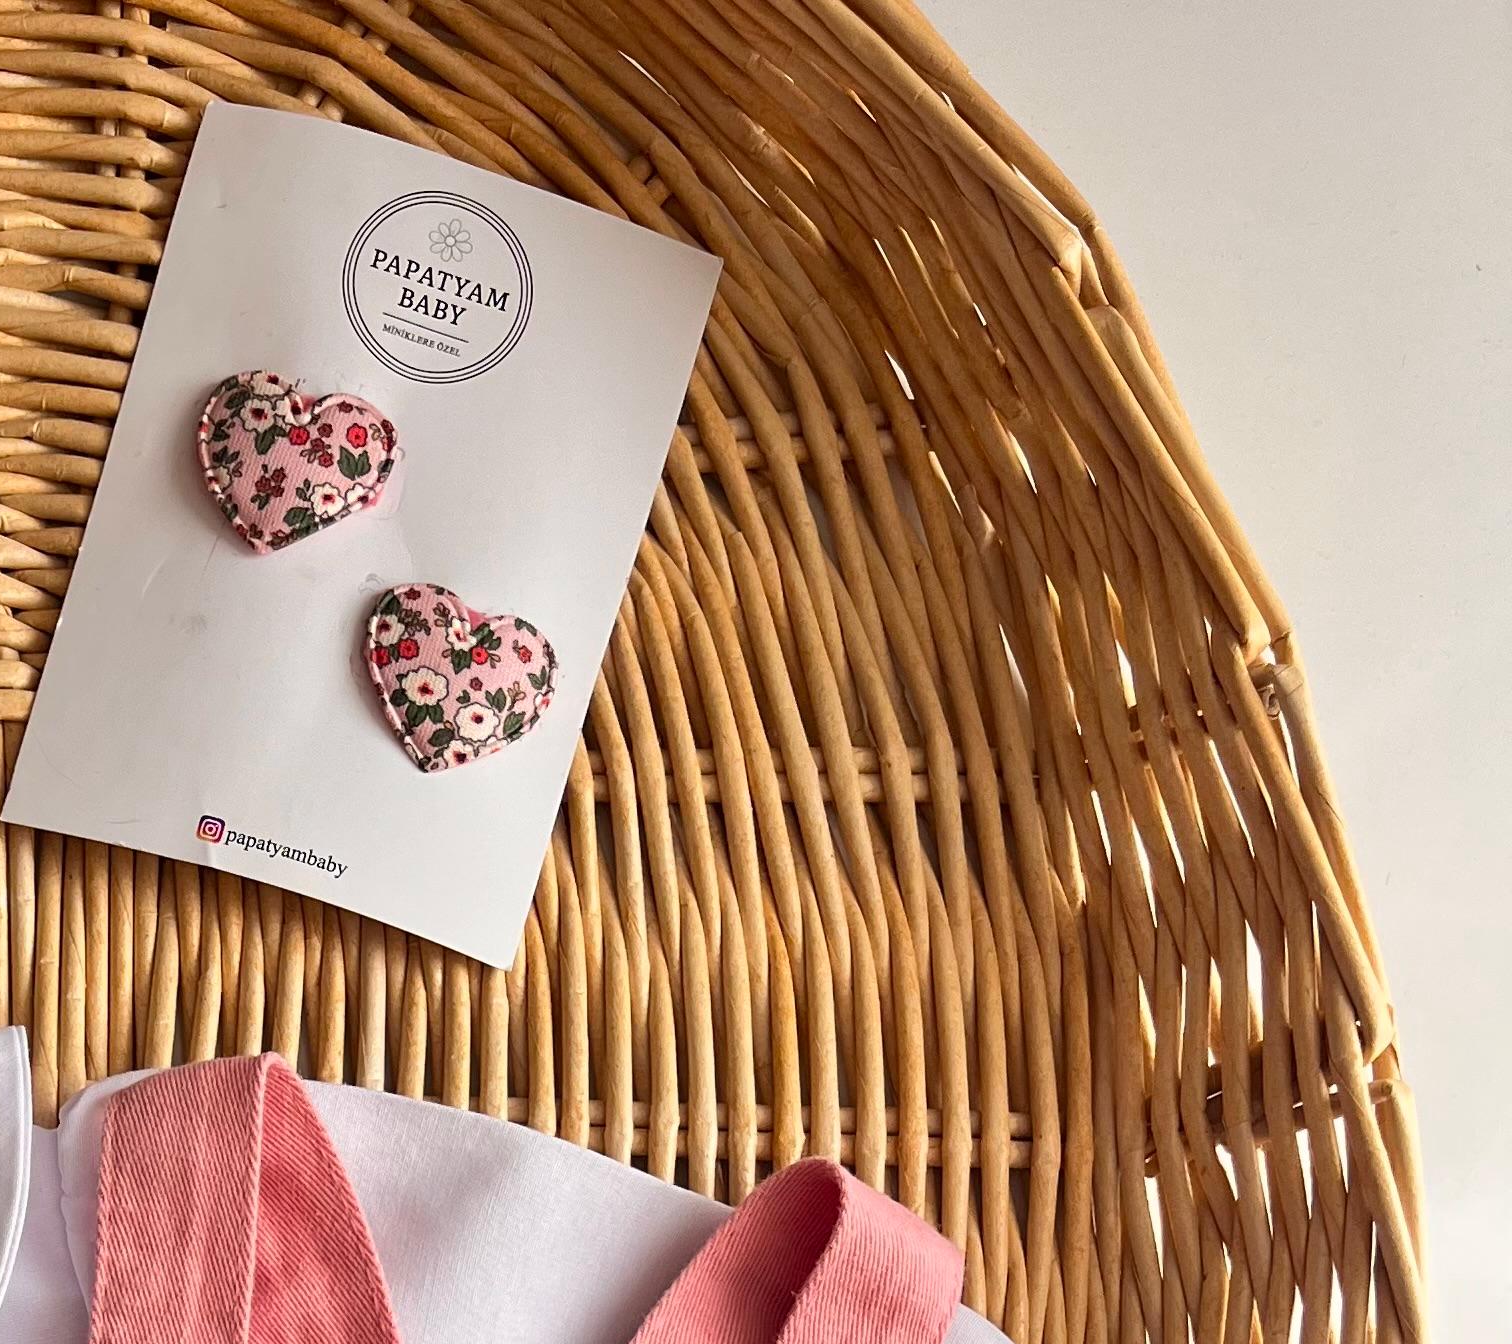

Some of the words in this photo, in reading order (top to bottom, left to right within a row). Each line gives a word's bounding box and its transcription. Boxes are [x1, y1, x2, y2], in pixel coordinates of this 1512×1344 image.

[370, 248, 510, 312] PAPATYAM
[398, 287, 467, 326] BABY
[437, 342, 461, 357] ÖZEL
[225, 830, 348, 878] papatyambaby
